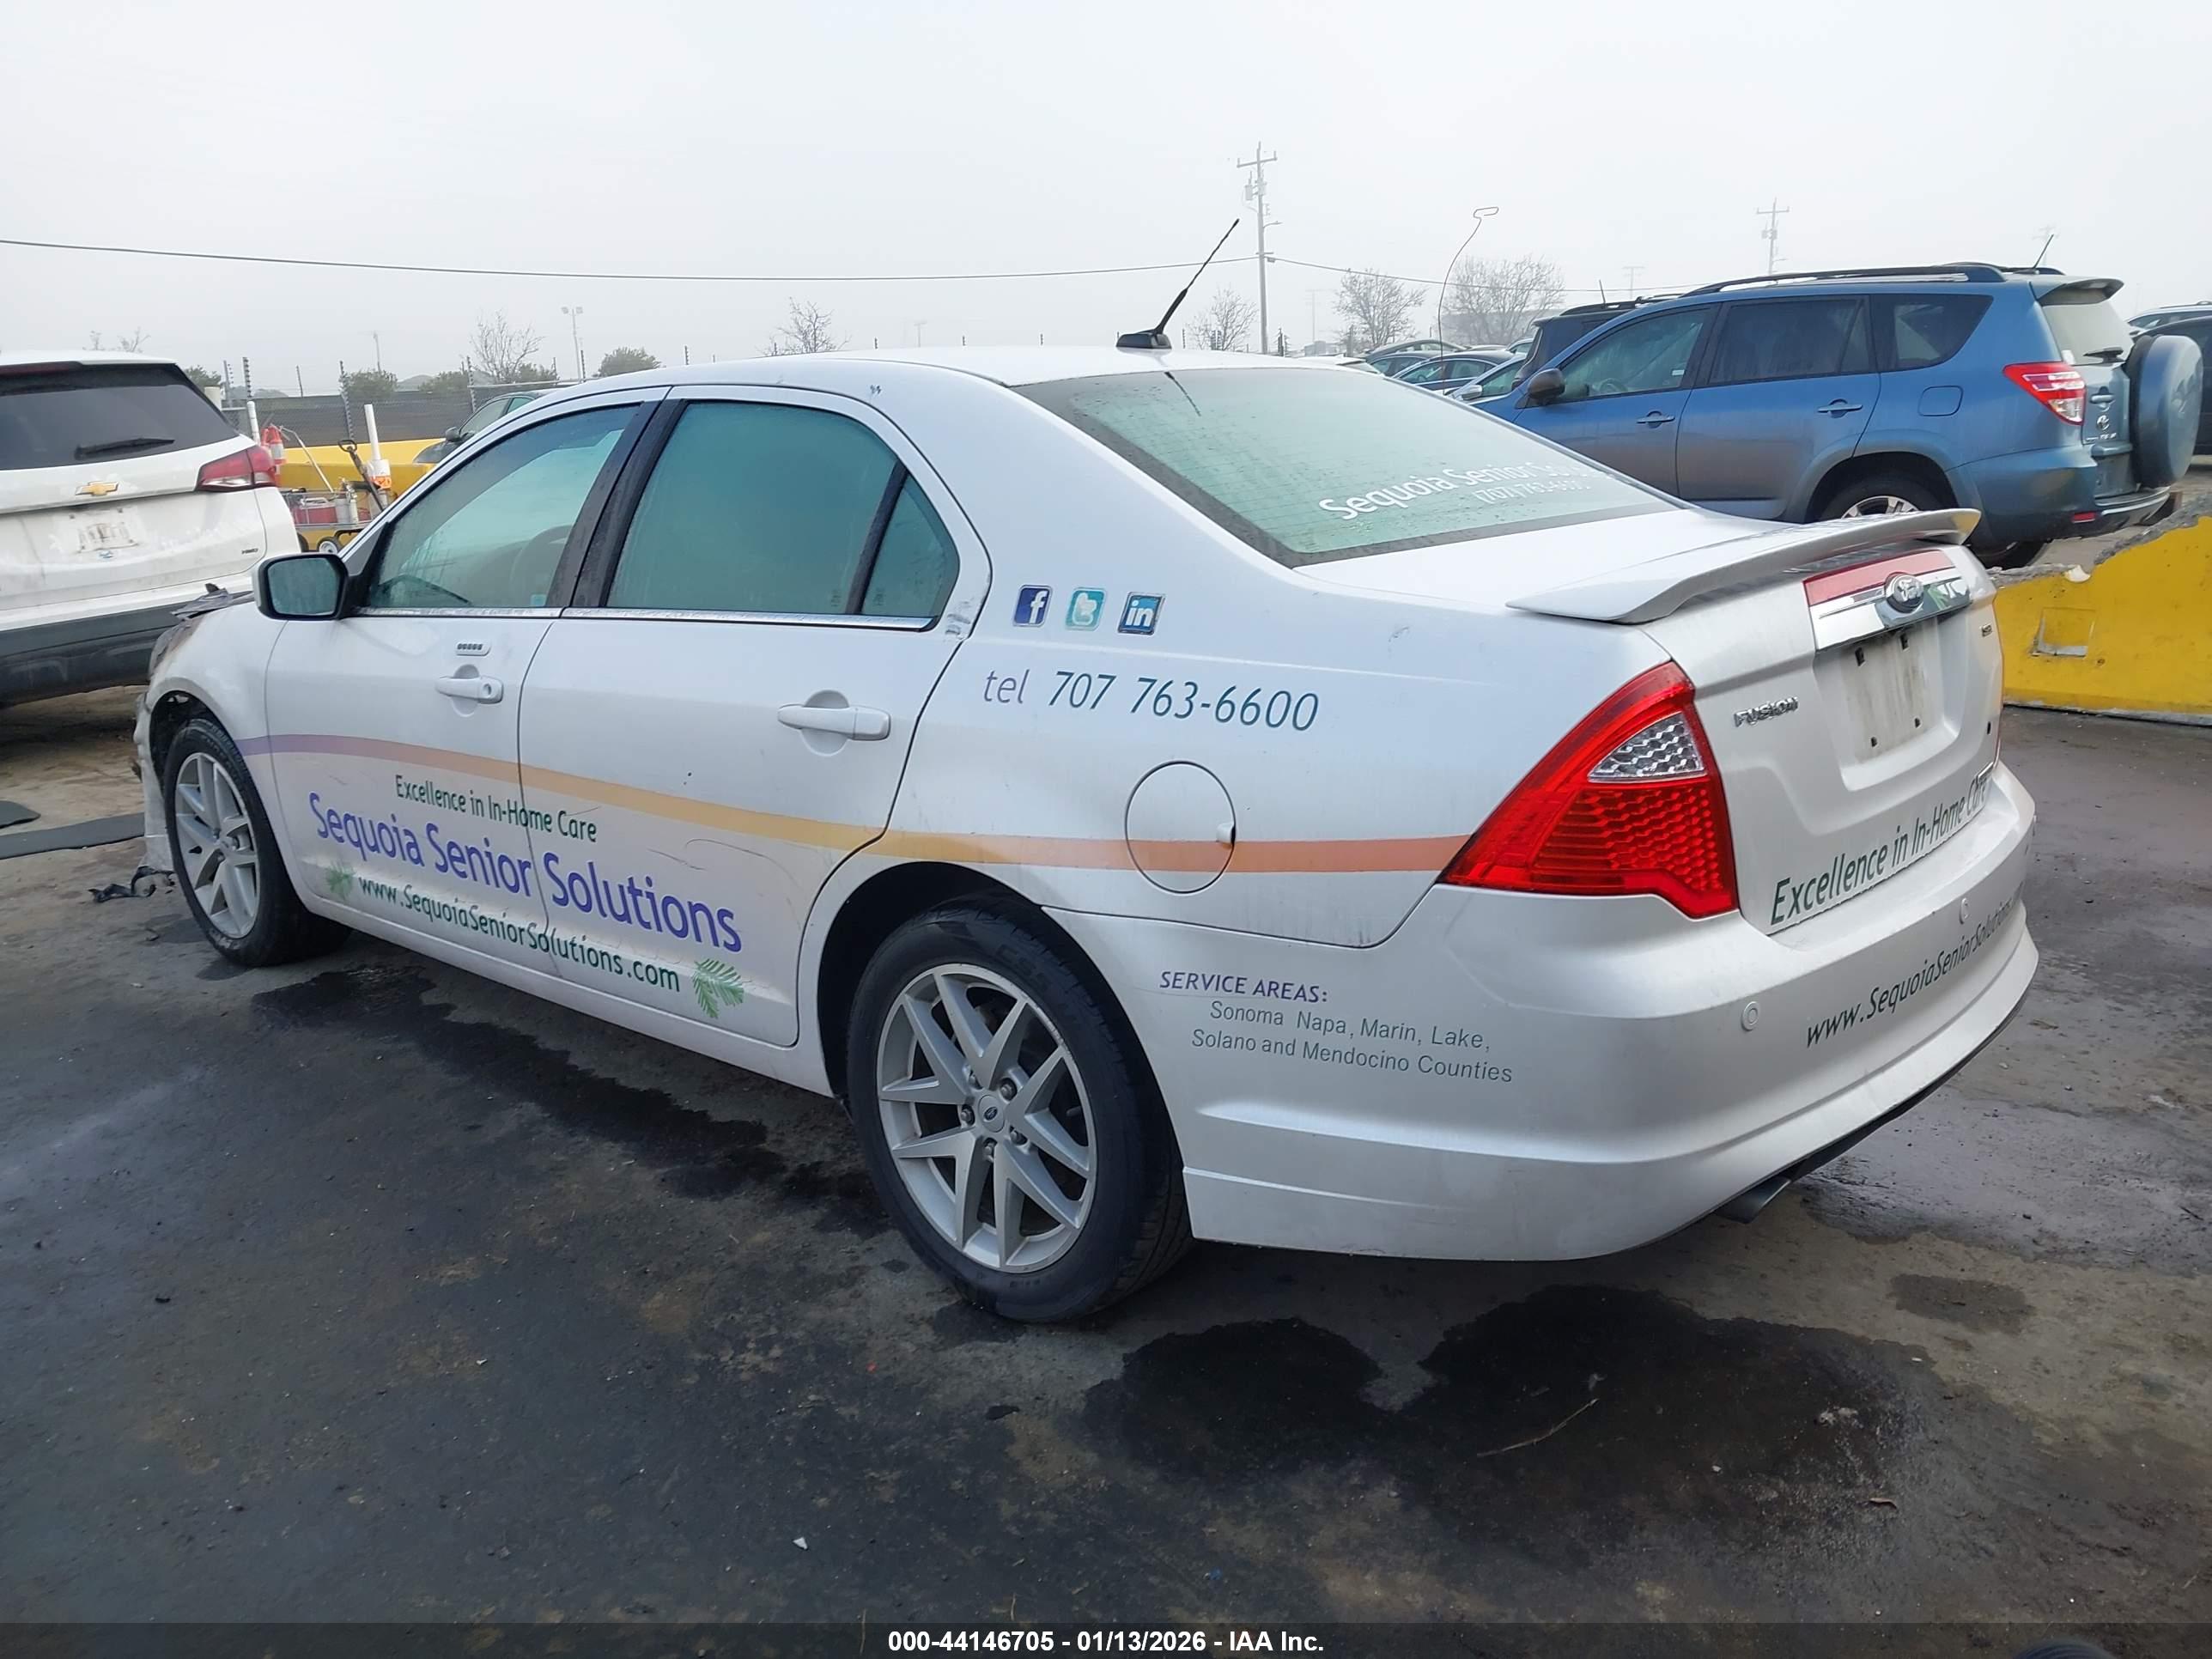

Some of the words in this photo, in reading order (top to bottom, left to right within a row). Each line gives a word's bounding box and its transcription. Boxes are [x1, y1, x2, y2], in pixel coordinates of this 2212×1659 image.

[1318, 475, 1452, 521] Sequoia
[1443, 462, 1537, 487] Senior
[983, 669, 1030, 704] tel
[1048, 671, 1116, 709] 707
[1131, 678, 1319, 732] 763-6600
[1734, 696, 1799, 727] FUSION
[395, 775, 467, 813] Excellence
[470, 790, 484, 816] in
[488, 799, 552, 833] In-Home
[558, 811, 597, 842] Care
[309, 793, 424, 867] Sequoia
[426, 823, 532, 897] Senior
[544, 852, 743, 953] Solutions
[1771, 847, 1887, 926] Excellence
[1890, 825, 1909, 866] in
[1911, 797, 1966, 853] In-Home
[359, 876, 680, 993] www.SequoiaSeniorSolutions.com
[1159, 971, 1248, 994] SERVICE
[1253, 980, 1328, 1003] AREAS:
[1192, 1029, 1257, 1053] Solano
[1261, 1037, 1297, 1057] and
[1303, 1042, 1410, 1073] Mendocino
[1418, 1055, 1513, 1084] Counties
[1210, 1000, 1284, 1025] Sonoma
[1297, 1011, 1355, 1038] Napa,
[1360, 1018, 1422, 1045] Marin,
[1431, 1026, 1491, 1052] Lake,
